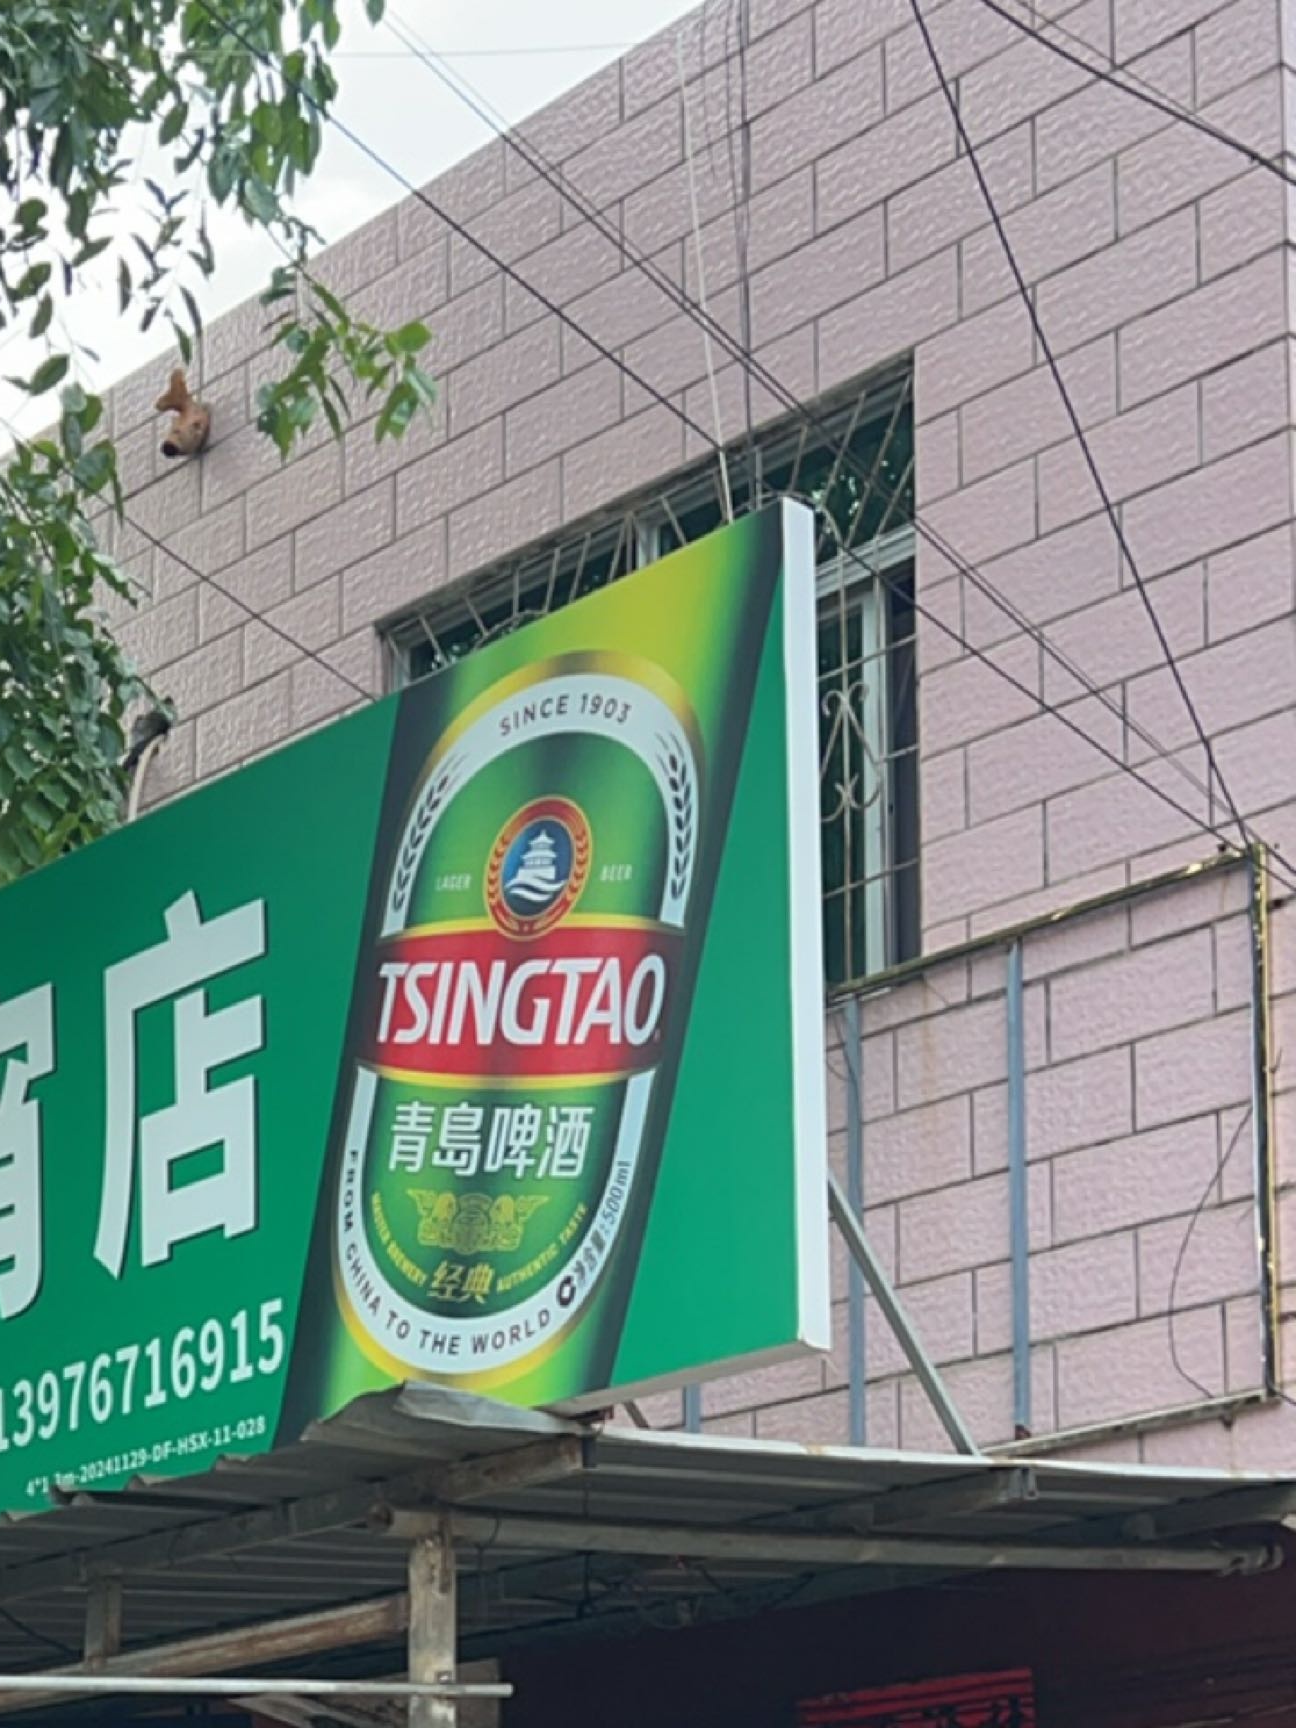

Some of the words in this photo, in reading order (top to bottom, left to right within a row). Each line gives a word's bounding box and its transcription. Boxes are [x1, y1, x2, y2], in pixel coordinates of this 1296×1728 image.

[499, 694, 570, 736] SINCE
[580, 692, 633, 724] 1903
[434, 873, 473, 891] LAGER
[600, 864, 633, 882] BEER
[376, 954, 666, 1046] TSINGTAO
[388, 1101, 596, 1180] 青島啤酒
[343, 1149, 359, 1233] FROM
[344, 1242, 382, 1316] CHINA
[385, 1309, 411, 1340] TO
[418, 1328, 462, 1356] THE
[469, 1307, 551, 1355] WORLD
